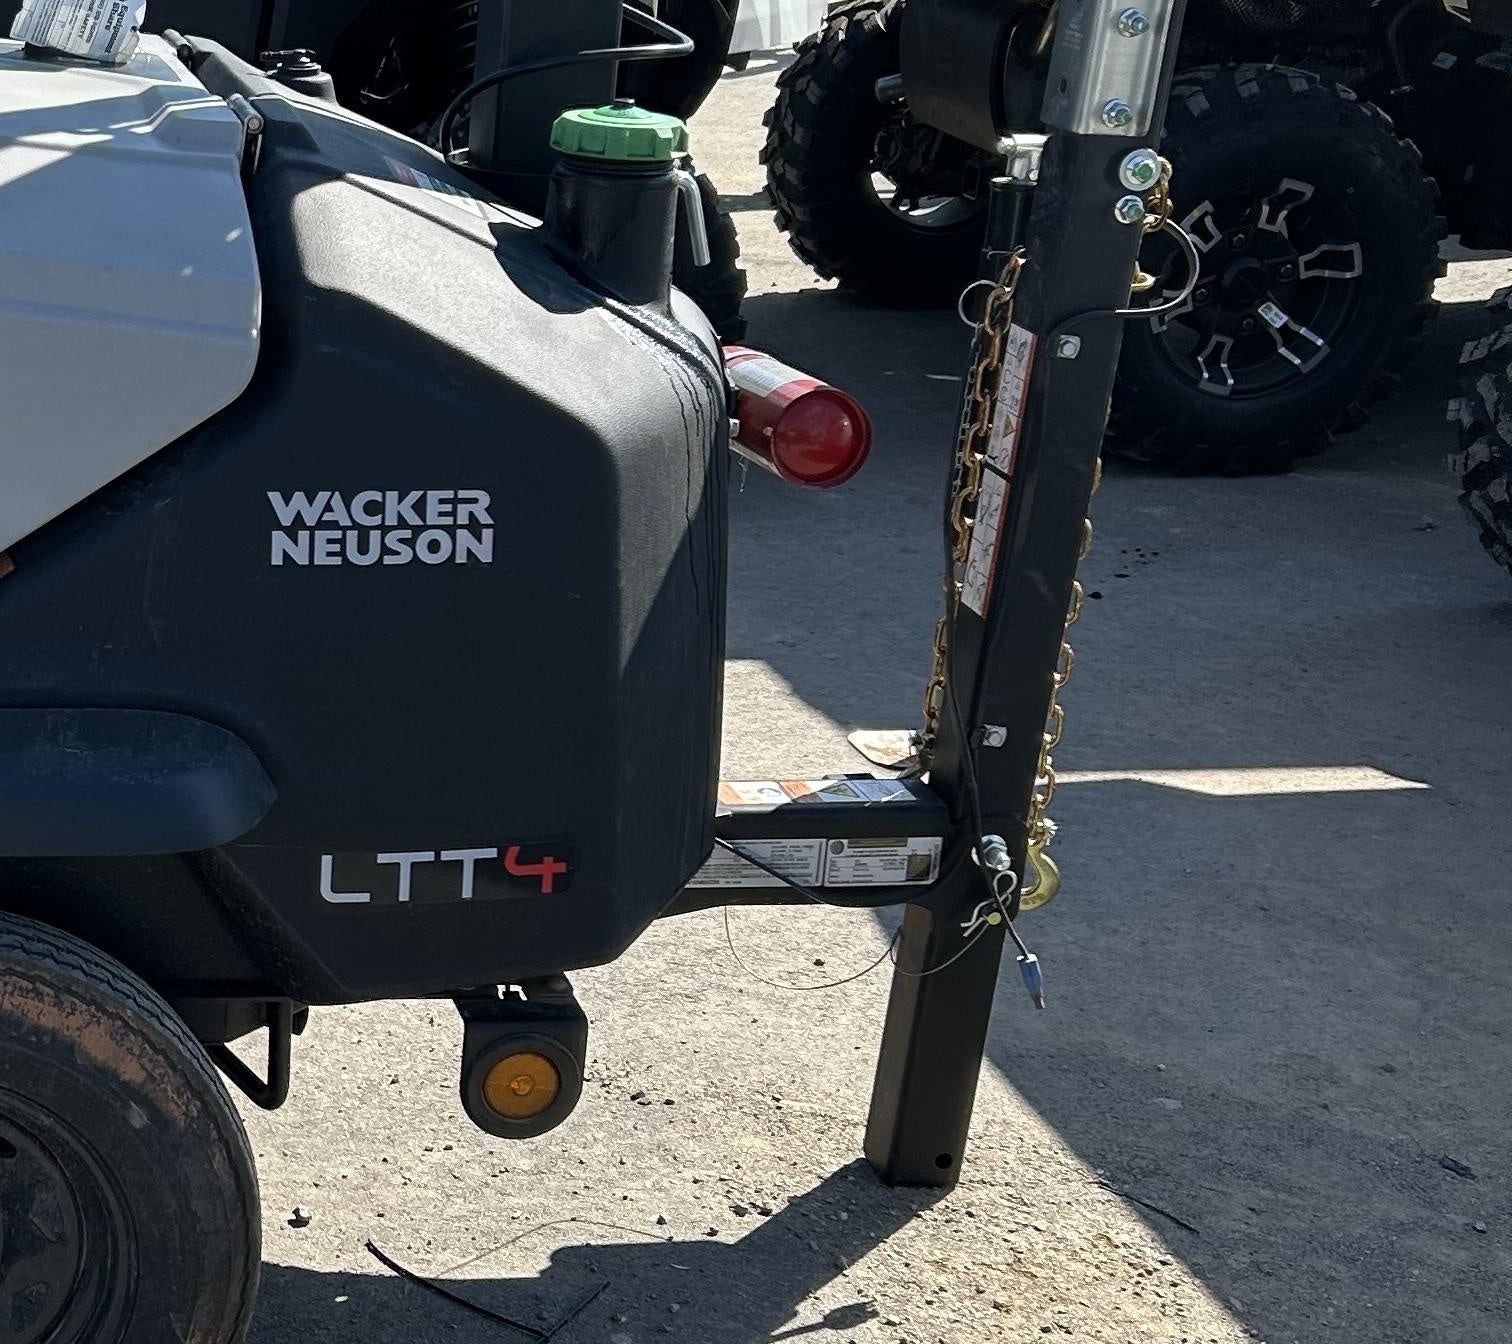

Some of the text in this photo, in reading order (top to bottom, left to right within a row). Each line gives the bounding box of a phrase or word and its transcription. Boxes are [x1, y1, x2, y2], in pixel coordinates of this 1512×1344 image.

[267, 489, 496, 527] WACKER
[271, 528, 494, 566] NEUSON
[320, 846, 567, 904] LTT4
